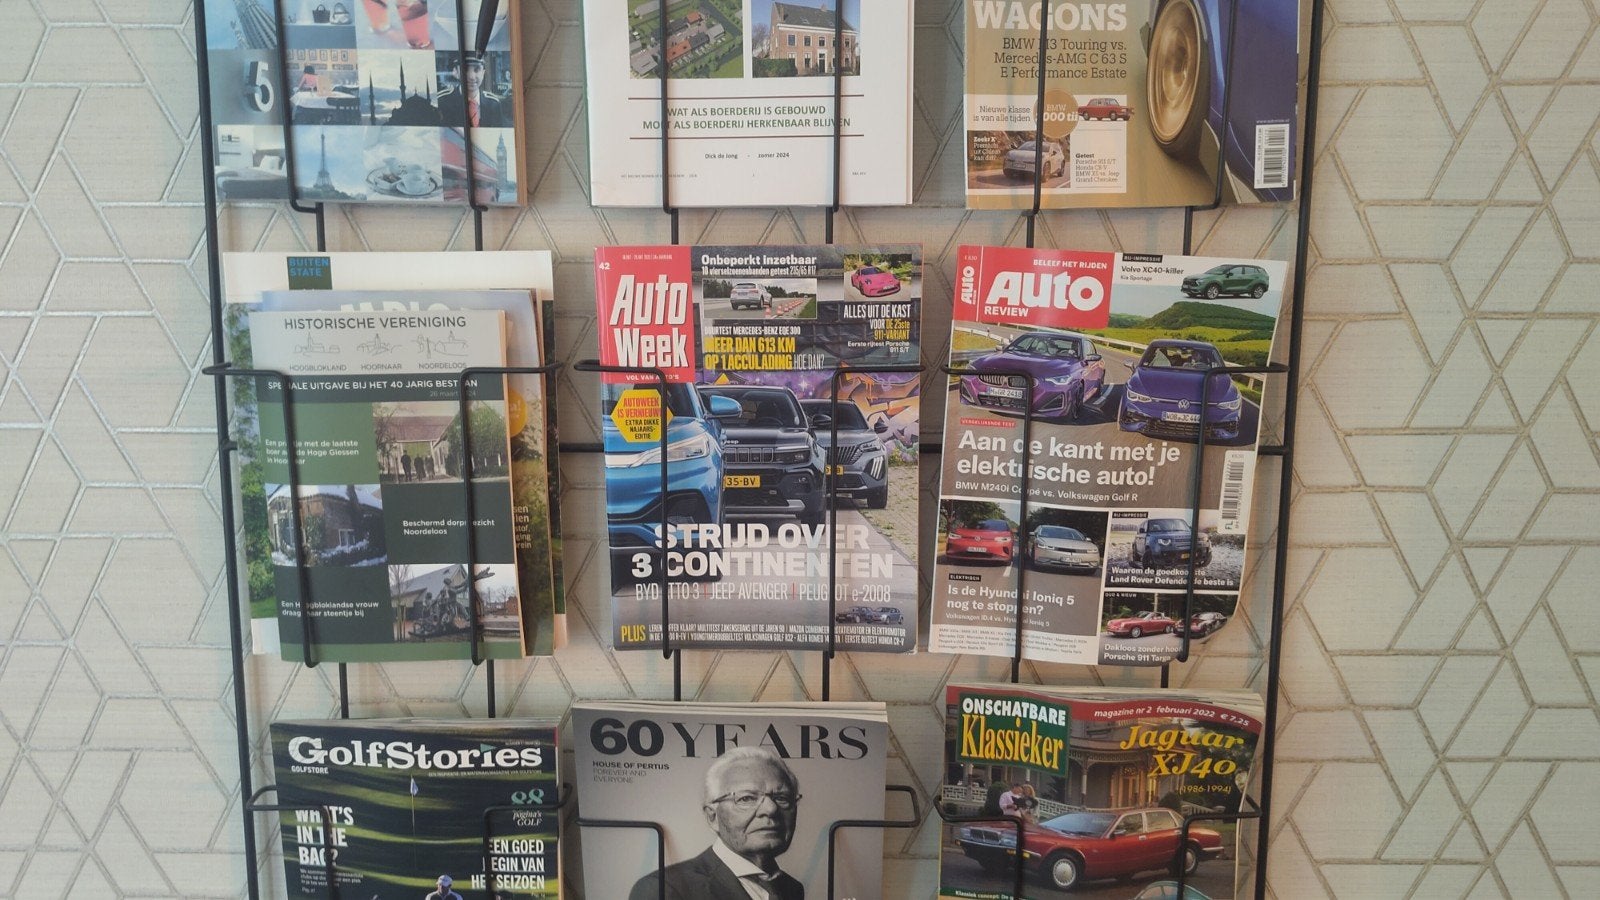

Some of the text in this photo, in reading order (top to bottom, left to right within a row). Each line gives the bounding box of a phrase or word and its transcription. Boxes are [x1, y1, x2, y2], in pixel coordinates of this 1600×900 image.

[973, 1, 1127, 31] WAGONS
[1003, 38, 1127, 53] BMW Touring vs.
[1089, 53, 1127, 64] C 63 S
[1000, 66, 1127, 78] E Perfomance Estate
[667, 105, 826, 116] WAT ALS BOERDERIJ IS GEBOUWD
[1008, 105, 1031, 113] klasse
[1046, 103, 1067, 111] BMW
[643, 119, 811, 129] MOT ALS BOERDERIJ HERKENBAAR
[995, 113, 1009, 122] alle
[1009, 113, 1031, 123] tijden
[289, 257, 329, 267] BUITEN
[599, 262, 610, 270] 42
[701, 254, 817, 267] Onbeperkt inzetbaar
[1033, 259, 1061, 267] BELEEF
[1079, 261, 1108, 270] RIJDEN
[290, 267, 322, 277] STATE
[1142, 266, 1185, 274] XC40-killer
[985, 271, 1104, 311] Auto
[609, 274, 688, 325] Auto
[843, 304, 912, 319] ALLES UIT DE KAST
[984, 305, 1029, 317] REVIEW
[284, 316, 467, 330] HISTORISCHE VERENIGING
[869, 318, 885, 329] VOOR
[613, 327, 689, 367] Week
[704, 337, 796, 353] MEER DAN 613 KM
[705, 354, 719, 370] OP
[728, 354, 793, 370] ACCULADING
[310, 379, 478, 390] UITGAVE BIJ HET 40 JARIG BESTAN
[958, 429, 1181, 466] Aan kant met je
[957, 454, 1155, 486] elektrische auto!
[955, 481, 979, 490] BMW
[981, 482, 1010, 492] M240i
[1057, 489, 1110, 502] Volkswagen
[1111, 492, 1130, 502] Golf
[1131, 494, 1138, 502] R
[402, 519, 445, 527] Beschermd
[403, 527, 448, 535] Noordeloos
[654, 523, 770, 549] STRIJD
[777, 523, 870, 549] OVER
[631, 551, 893, 578] 3 CONTINENTEN
[1111, 566, 1155, 575] Waarom de
[1110, 575, 1234, 586] Land Rover beste is
[635, 582, 891, 602] BYD 3 JEEP AVENGER e-2008
[948, 584, 1075, 606] Is de Ioniq 5
[947, 600, 984, 611] nog te
[621, 624, 646, 642] PLUS
[1104, 643, 1164, 653] Dakloos zonder
[1103, 652, 1136, 661] Porsche
[1137, 654, 1150, 662] 911
[962, 697, 1066, 727] ONSCHATBARE
[1094, 705, 1216, 719] magazine nr 2 februari 2022
[590, 717, 869, 760] 60 YEARS
[961, 713, 1064, 770] Klassieker
[1120, 725, 1244, 751] Jaguar
[288, 736, 542, 769] GolfStories
[291, 765, 329, 774] GOLFSTORE
[592, 760, 621, 768] HOUSE
[1147, 751, 1237, 779] XJ40
[1179, 785, 1232, 795] (1986-1994)
[517, 818, 542, 826] GOLF
[296, 825, 314, 844] IN
[511, 839, 545, 855] GOED
[521, 857, 545, 872] VAN
[496, 874, 545, 890] SEIZOEN
